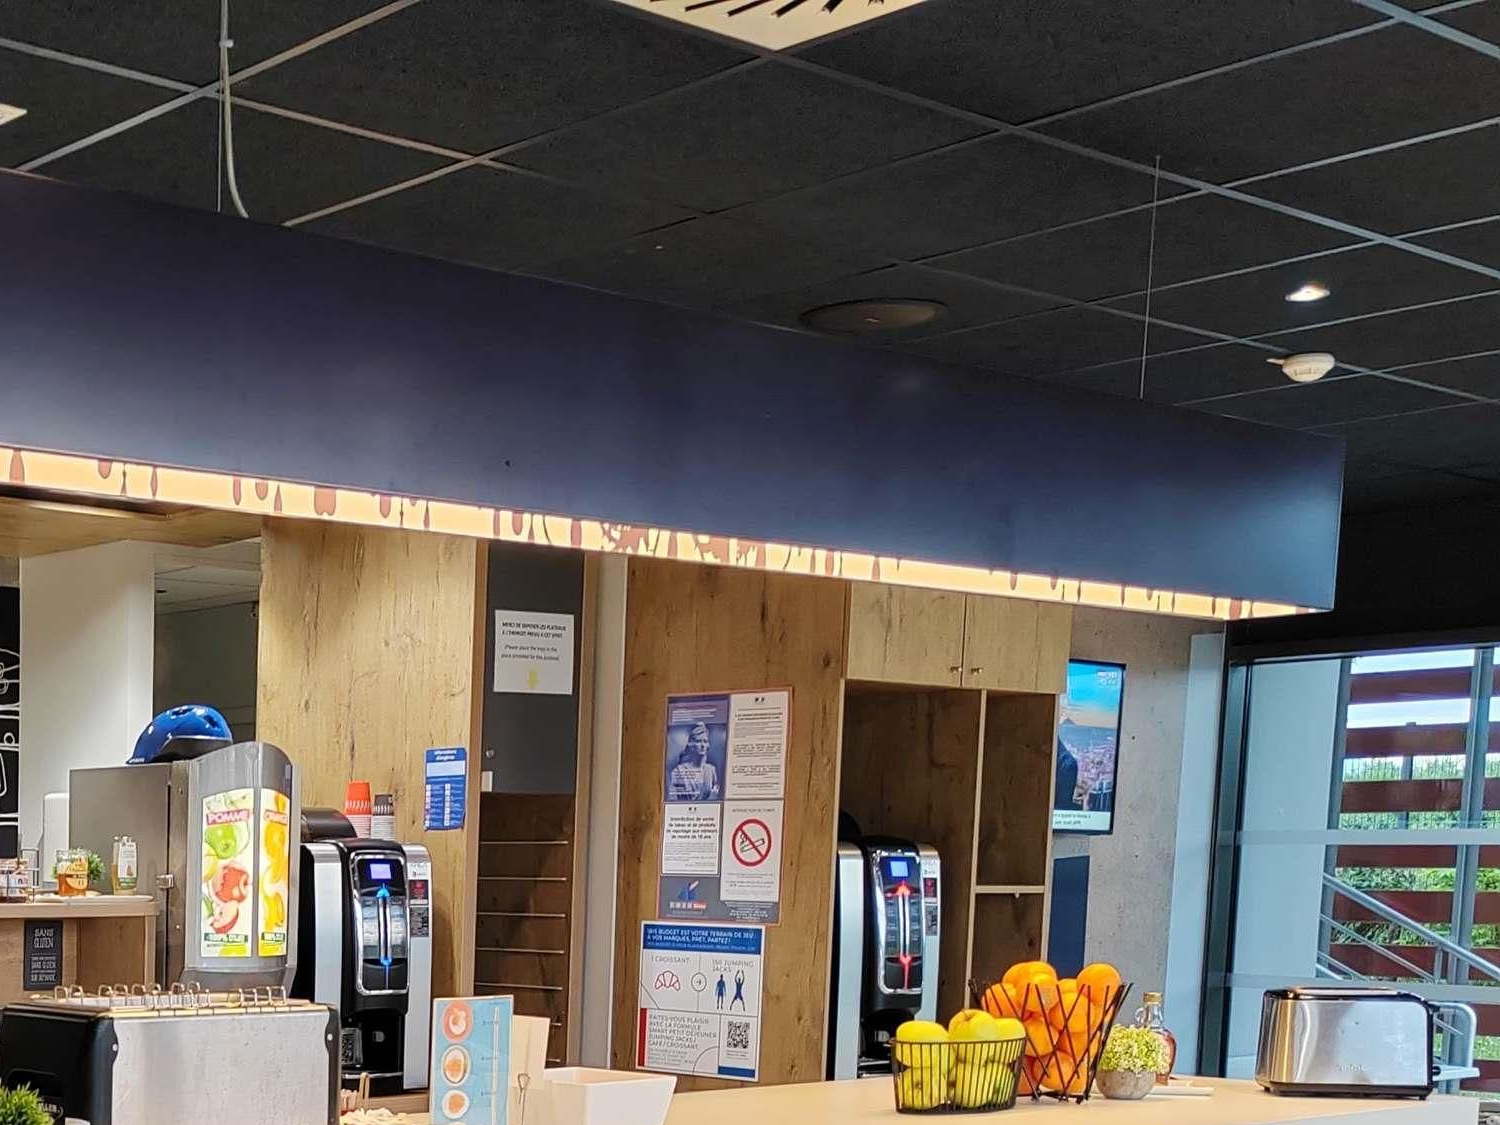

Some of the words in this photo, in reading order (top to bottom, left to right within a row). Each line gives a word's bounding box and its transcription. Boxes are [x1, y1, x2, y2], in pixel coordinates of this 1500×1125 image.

[655, 956, 690, 964] CROISSANT
[724, 960, 754, 968] JUMPING
[672, 1022, 700, 1030] FORMULE
